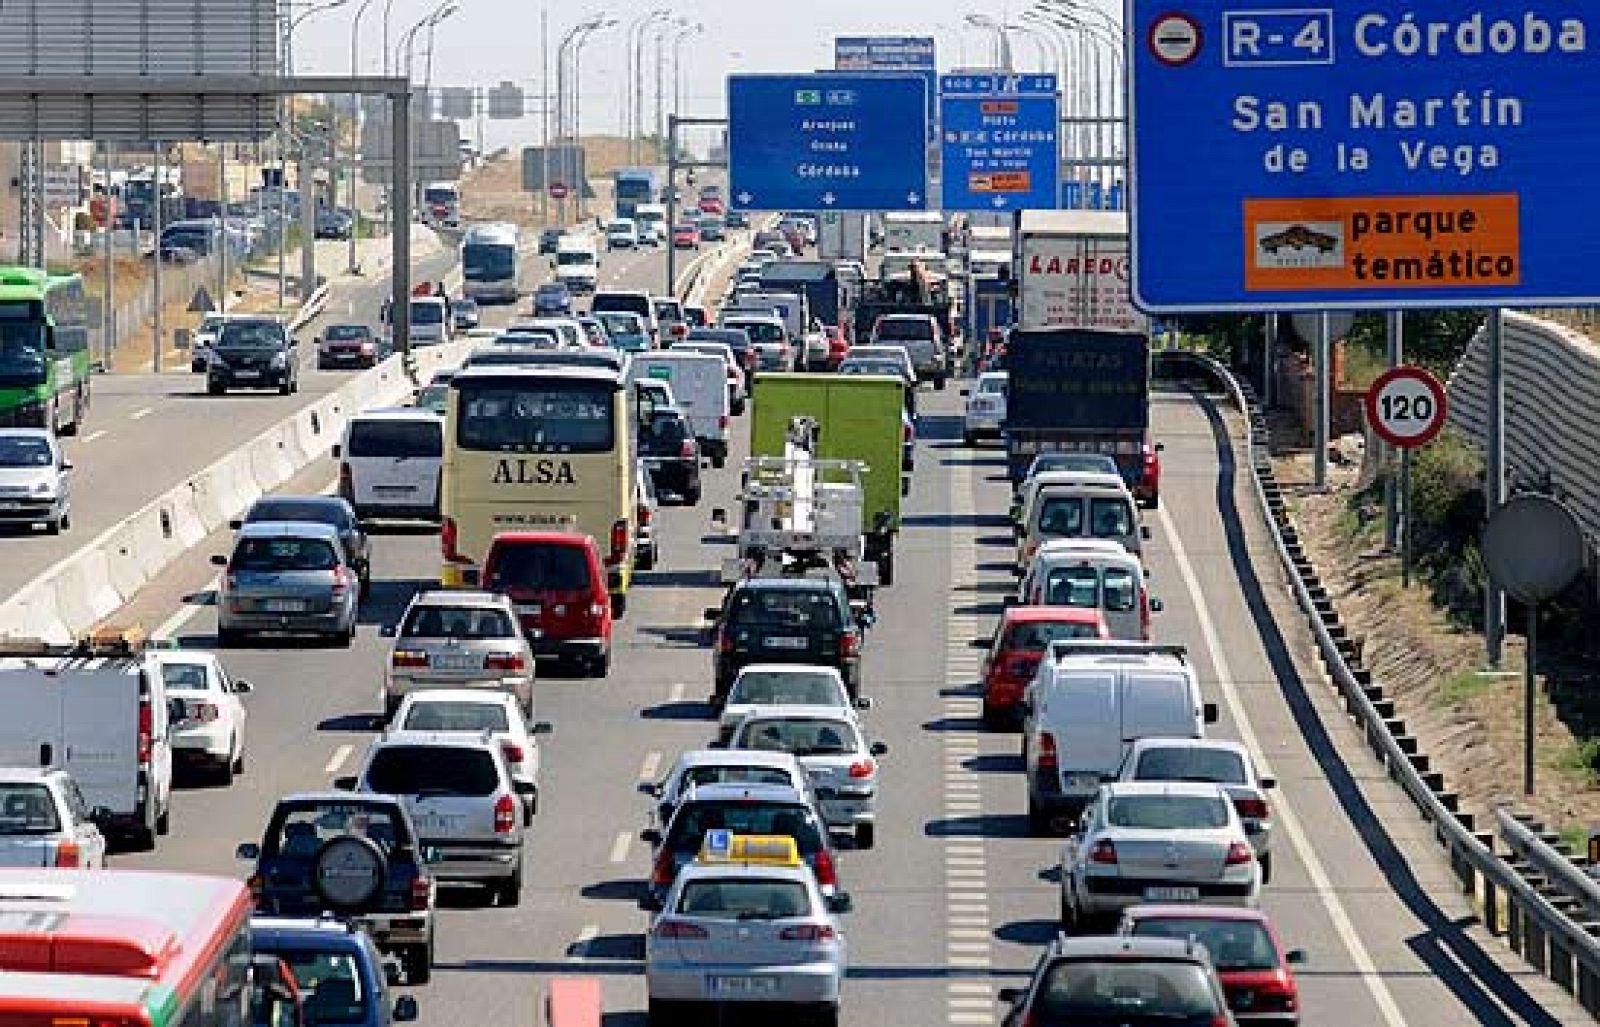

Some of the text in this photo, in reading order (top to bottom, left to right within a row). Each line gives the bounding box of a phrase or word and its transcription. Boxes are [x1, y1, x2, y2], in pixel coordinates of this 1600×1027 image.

[1233, 12, 1586, 56] R-4 Córdoba
[1232, 90, 1522, 131] San Martín
[798, 163, 860, 178] Córdoba
[1264, 139, 1498, 175] de la Vega
[1352, 208, 1477, 241] parque
[1352, 250, 1514, 280] temático
[1381, 395, 1432, 420] 120
[492, 459, 576, 484] ALSA
